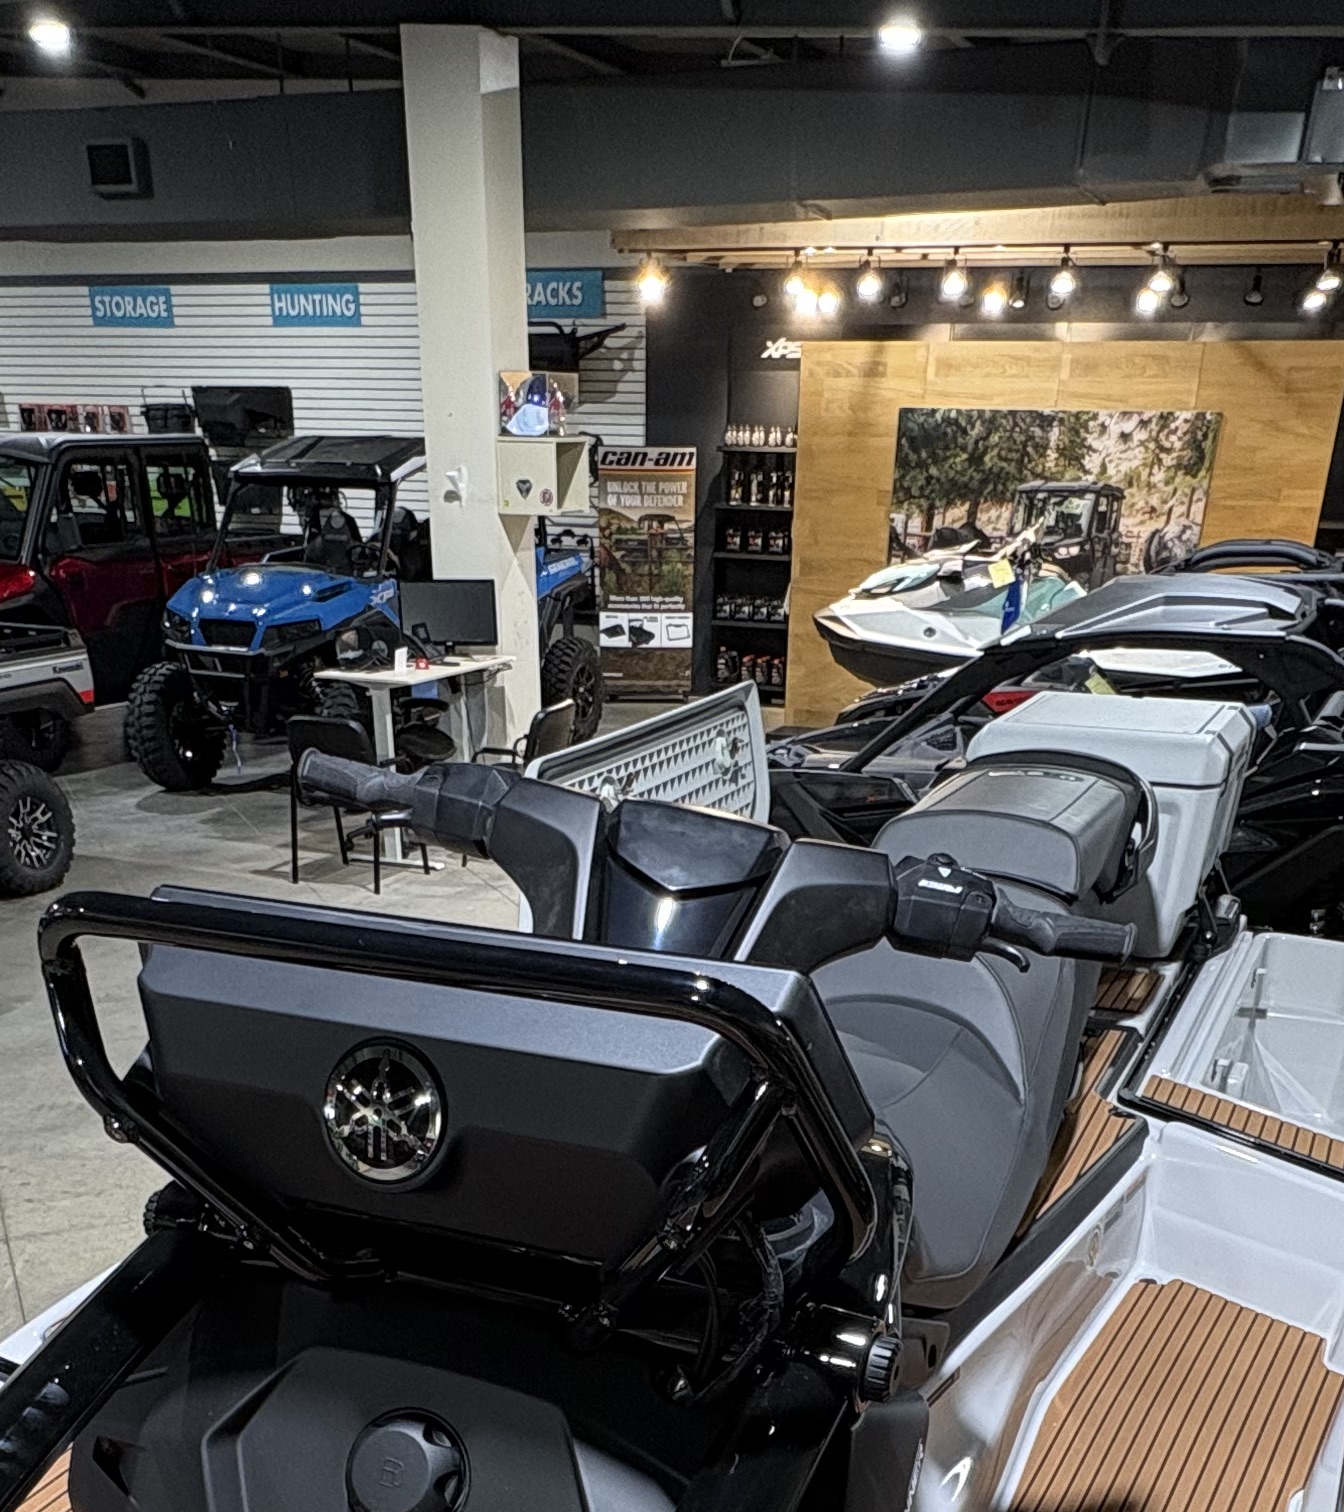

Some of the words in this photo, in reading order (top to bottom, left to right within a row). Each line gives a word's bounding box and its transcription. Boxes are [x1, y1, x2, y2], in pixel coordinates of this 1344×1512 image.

[94, 294, 168, 320] STORAGE
[273, 291, 357, 319] HUNTING
[600, 450, 696, 467] can-am
[607, 481, 641, 494] UNLOCK
[641, 481, 656, 494] THE
[658, 481, 688, 494] POWER
[607, 494, 617, 507] OF
[620, 494, 642, 507] YOUR
[643, 494, 684, 507] DEFENDER
